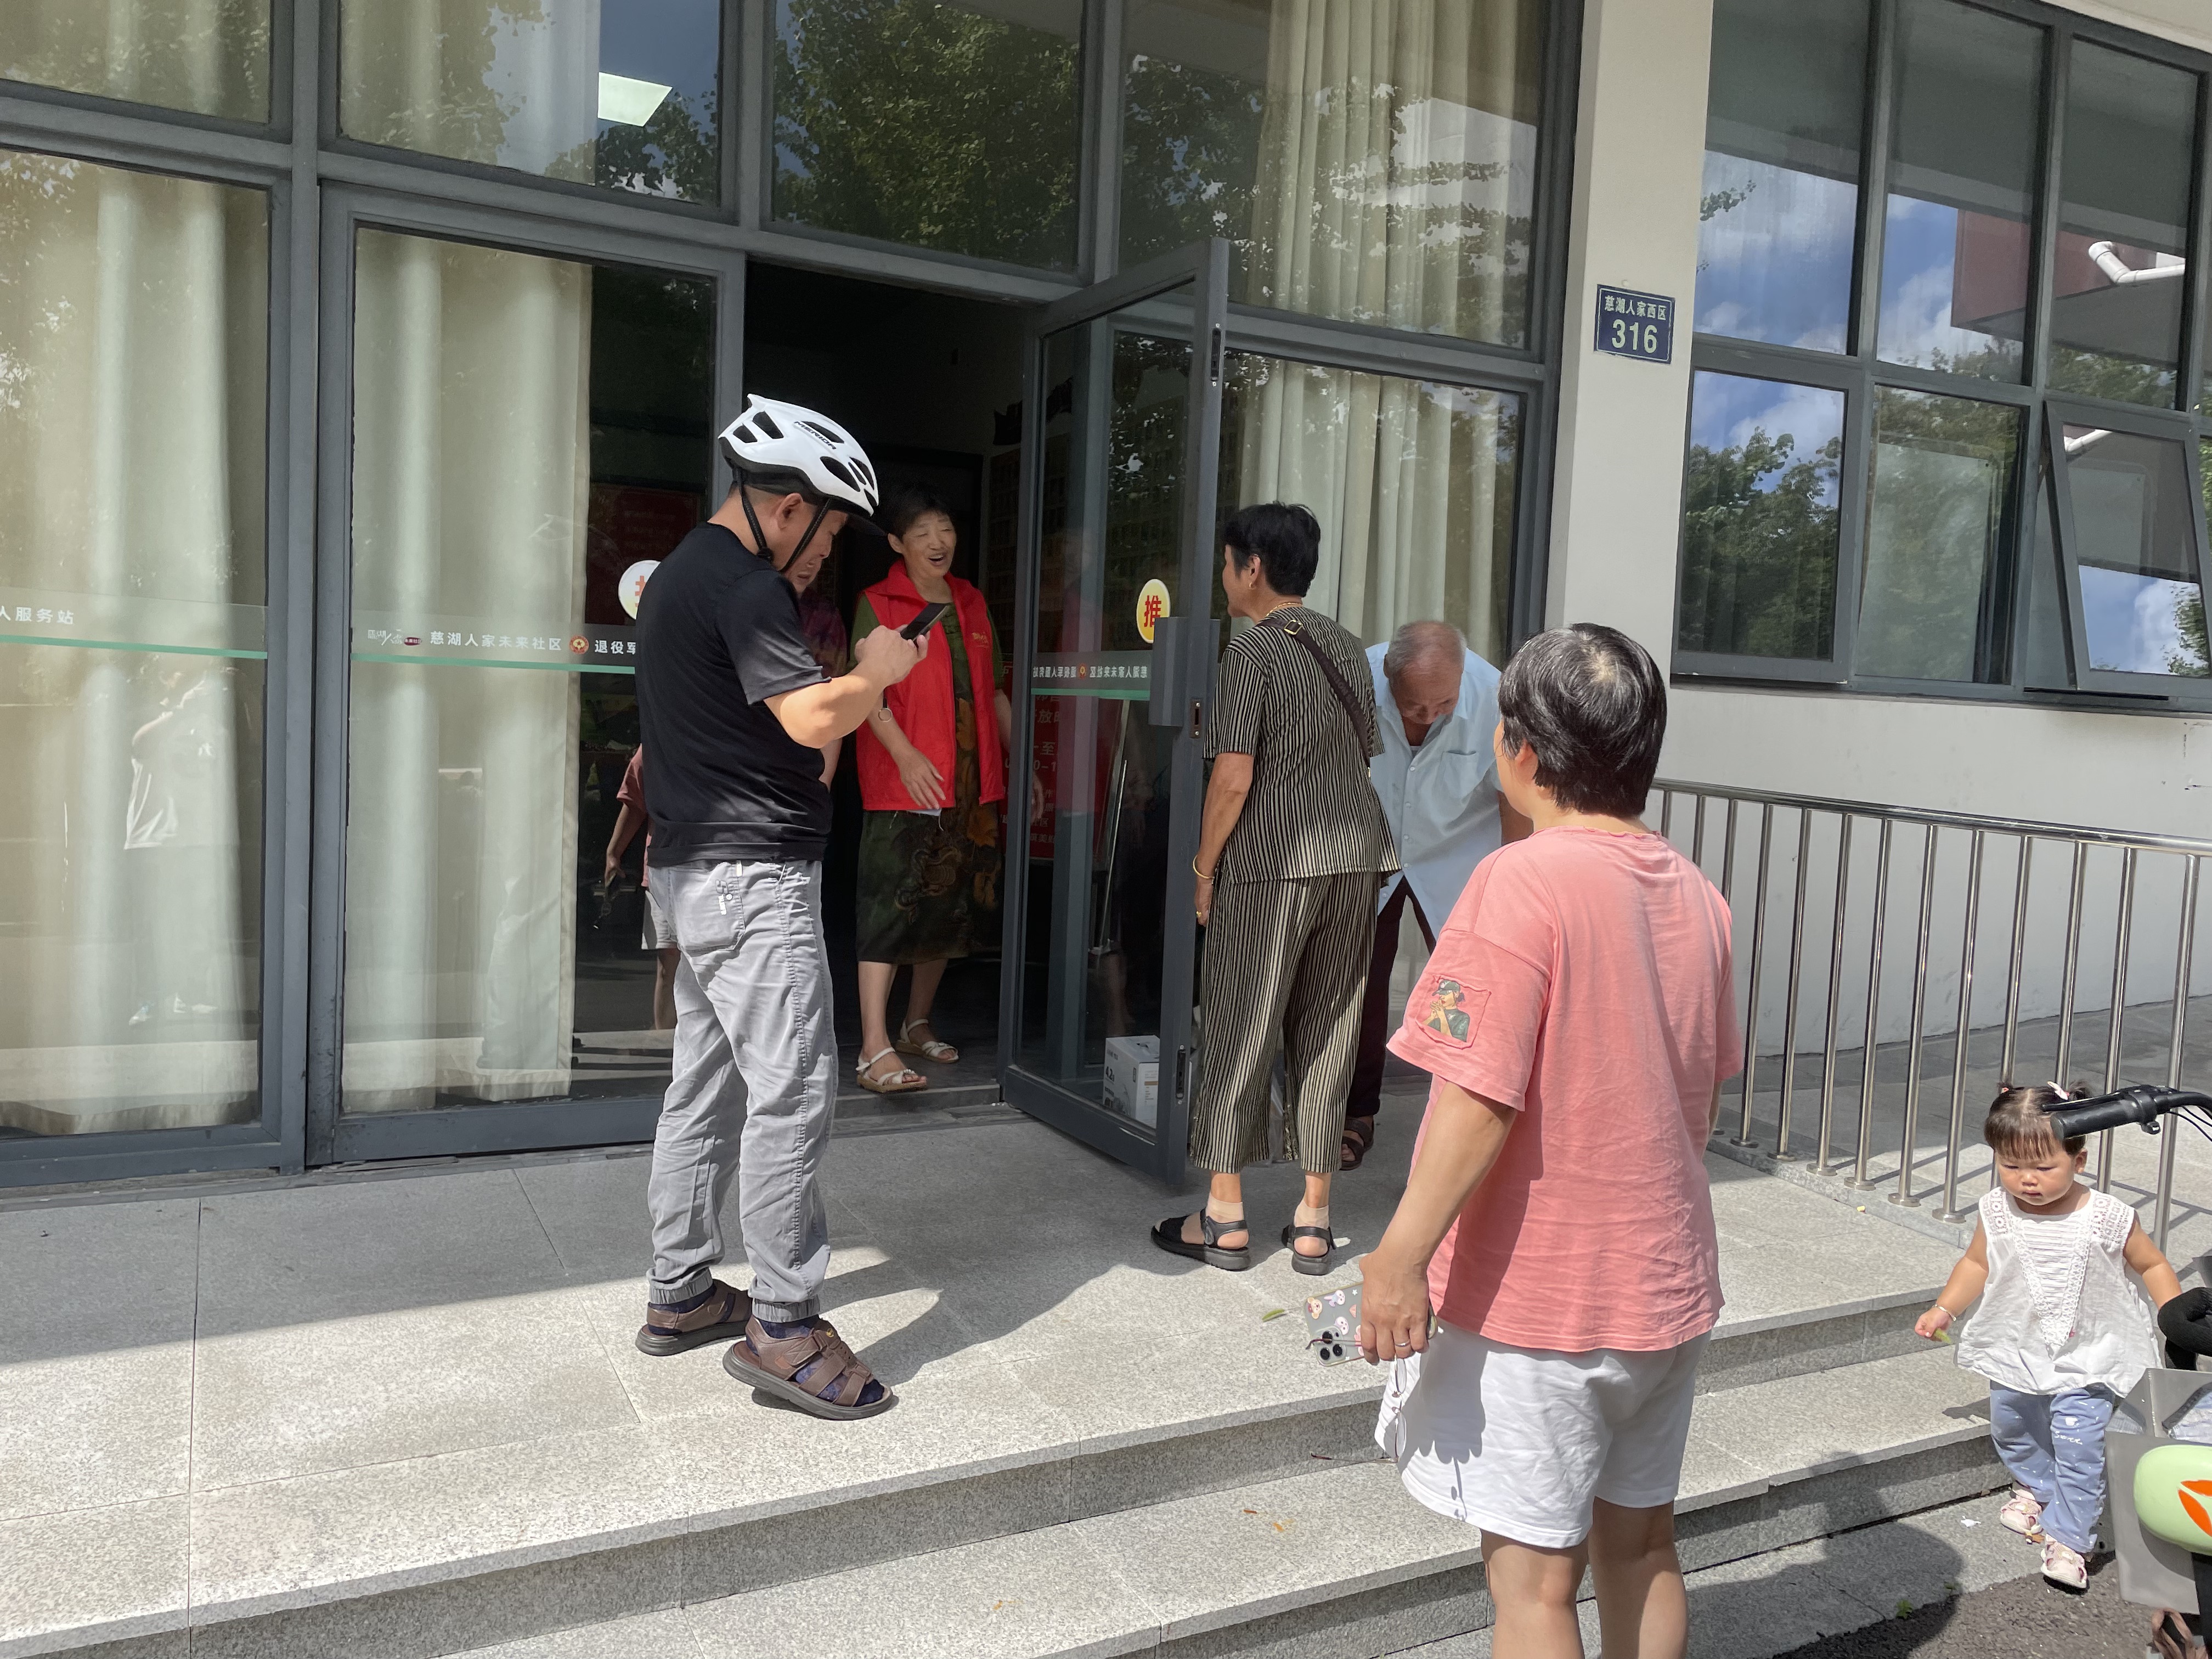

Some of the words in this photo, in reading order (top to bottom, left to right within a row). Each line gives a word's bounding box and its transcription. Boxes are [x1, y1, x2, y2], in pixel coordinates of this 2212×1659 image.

[1605, 295, 1667, 320] 慈湖人家西区
[1612, 319, 1657, 353] 316
[0, 605, 75, 625] 人服务站
[1144, 595, 1162, 628] 推
[430, 630, 562, 652] 慈湖人家未来社区
